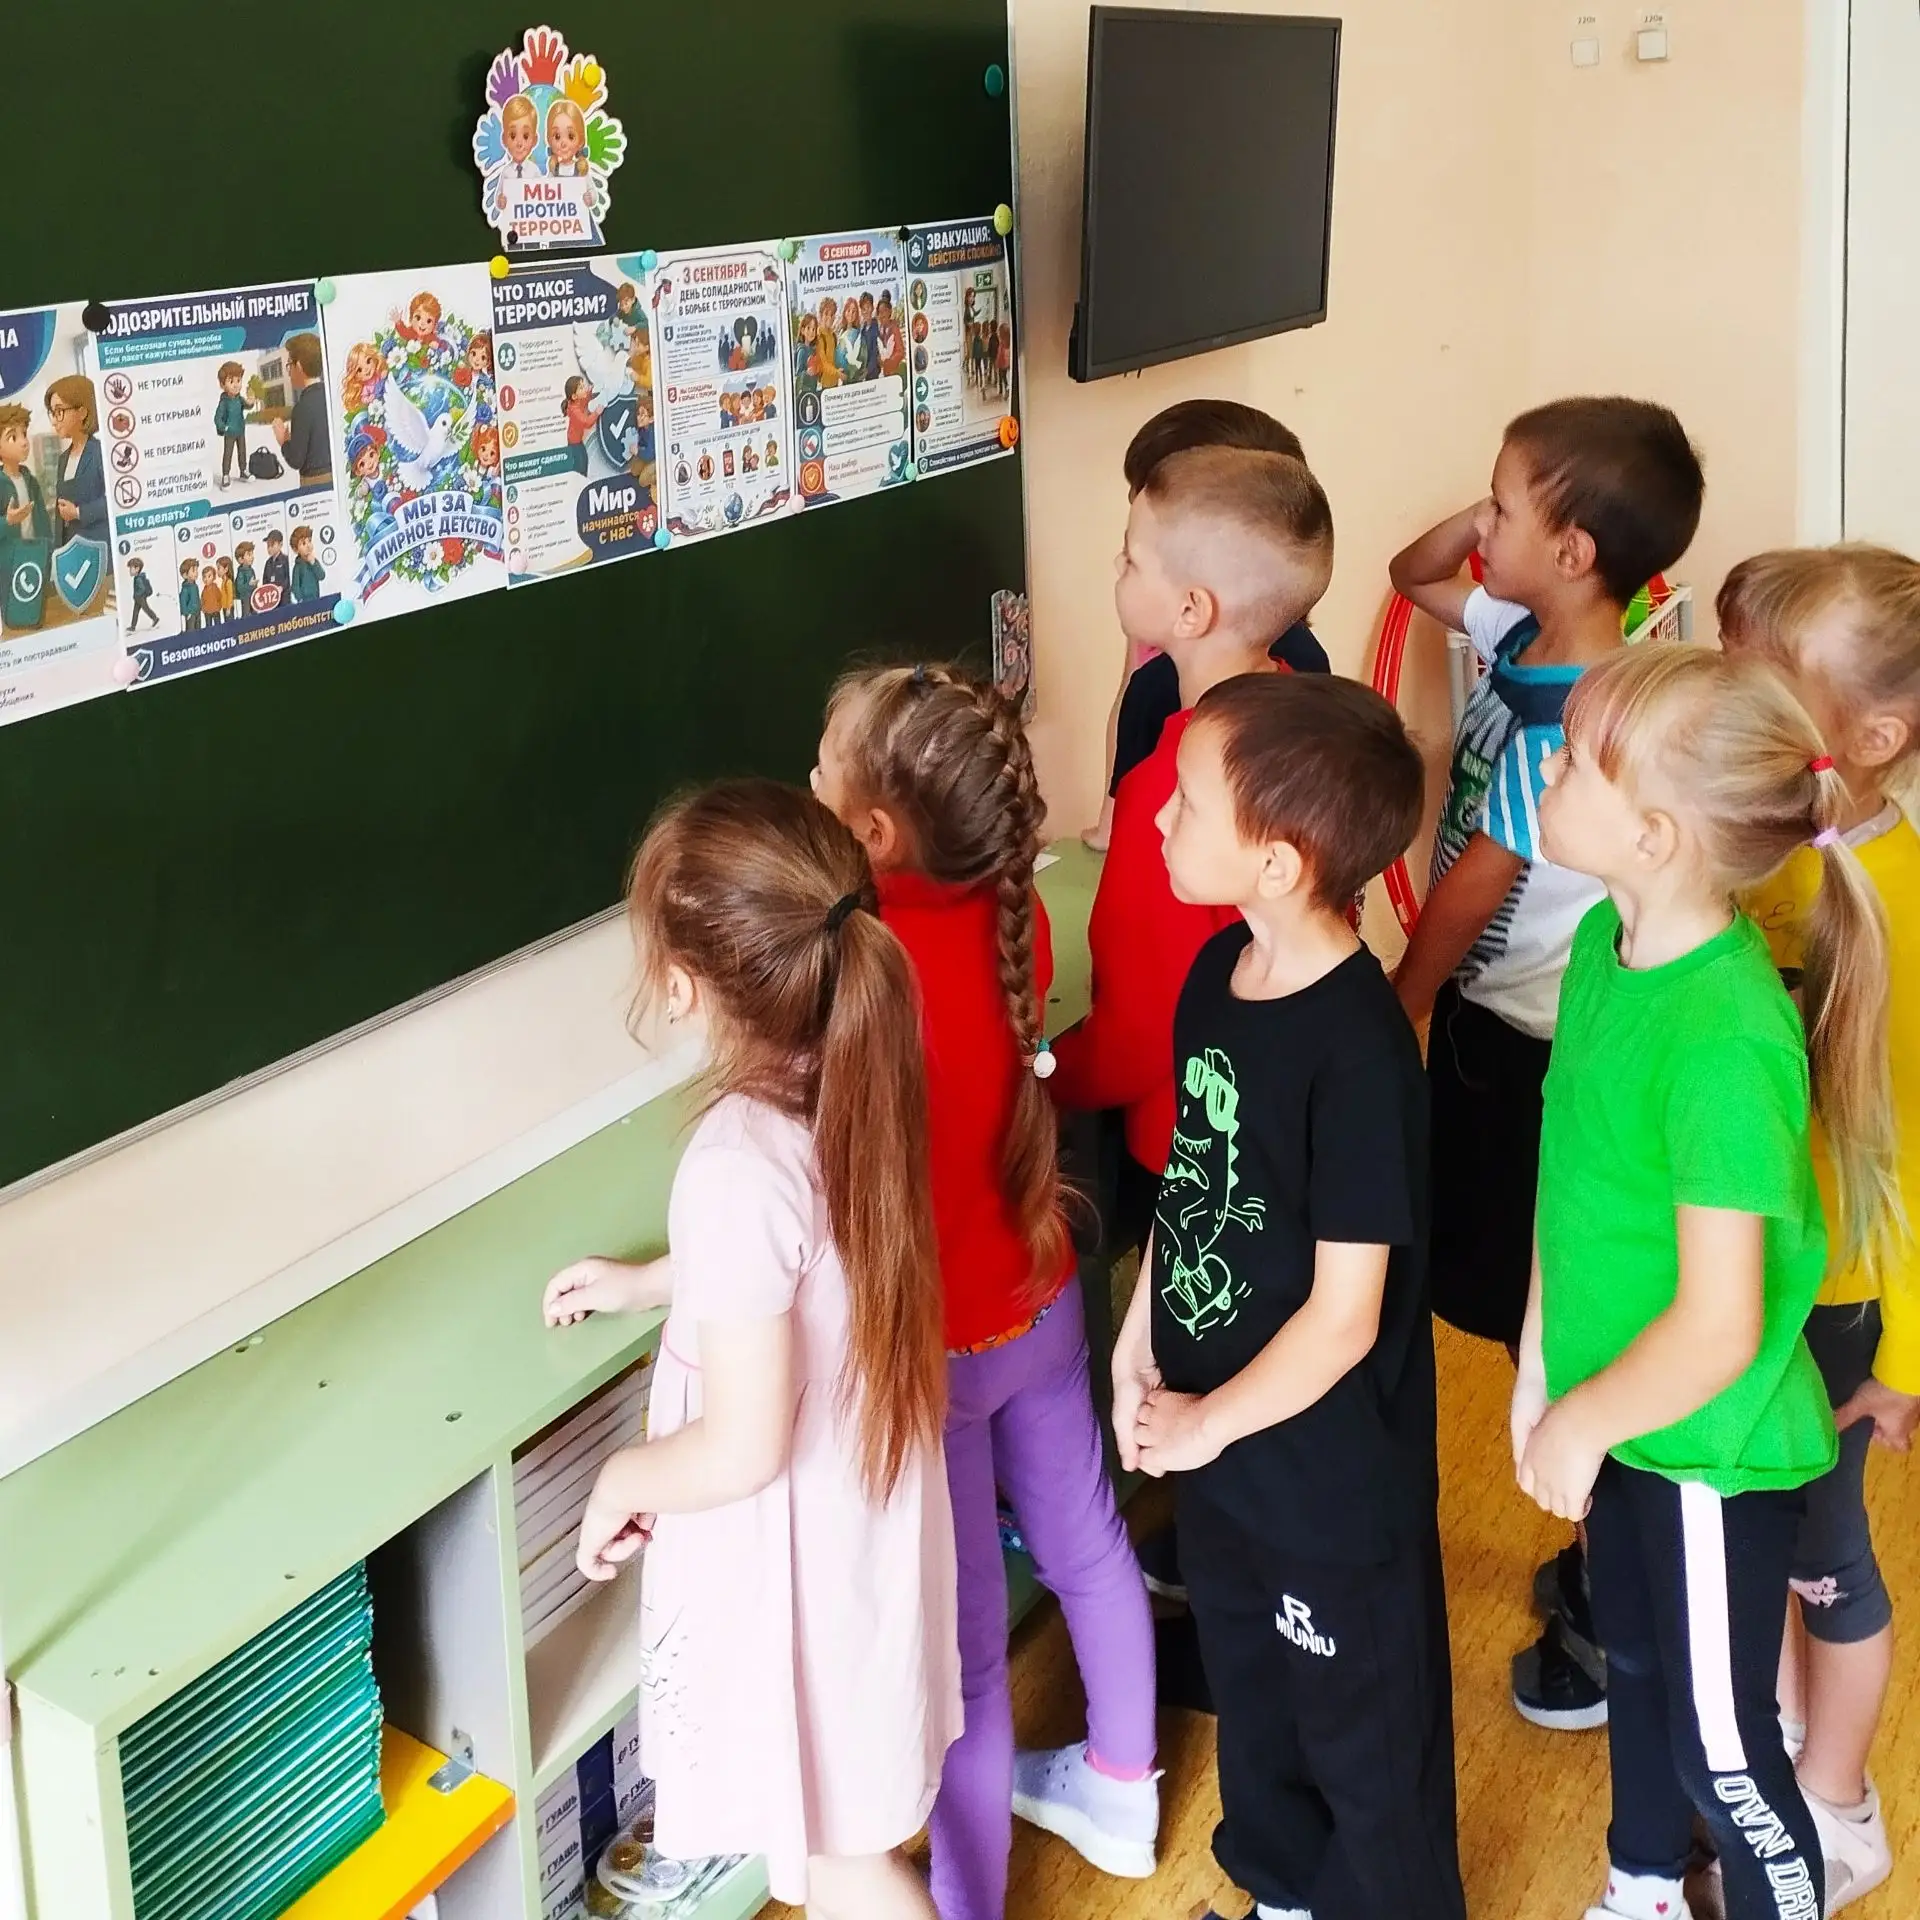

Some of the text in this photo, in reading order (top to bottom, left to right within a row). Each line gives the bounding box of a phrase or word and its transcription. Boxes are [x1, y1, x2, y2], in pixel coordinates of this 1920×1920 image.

[523, 184, 562, 201] МЫ
[514, 202, 577, 218] ПРОТИВ
[509, 219, 584, 237] ТЕРРОРА
[926, 226, 991, 251] ЭВАКУАЦИЯ:
[823, 244, 868, 259] 3 СЕНТЯБРЯ
[683, 267, 691, 284] 3
[693, 263, 747, 282] СЕНТЯБРЯ
[800, 256, 898, 284] МИР БЕЗ ТЕРРОРА
[493, 278, 574, 303] ЧТО ТАКОЕ
[680, 280, 763, 303] ДЕНЬ СОЛИДАРНОСТИ
[97, 292, 310, 336] ОДОЗРИТЕЛЬНЫЙ ПРЕДМЕТ
[495, 294, 607, 326] ТЕРРОРИЗМ?
[679, 295, 766, 316] В БОРЬБЕ С ТЕРРОРИЗМОМ
[104, 333, 222, 355] Если бесхозная сумка, коробка
[106, 354, 119, 364] или
[120, 351, 144, 363] пакет
[145, 347, 177, 361] кажутся
[138, 375, 184, 390] НЕ ТРОГАЙ
[141, 407, 201, 425] НЕ ОТКРЫВАЙ
[144, 439, 206, 459] НЕ ПЕРЕДВИГАЙ
[505, 453, 568, 471] Что может сделать
[146, 469, 202, 488] НЕ ИСПОЛЬЗУЙ
[148, 480, 208, 498] РЯДОМ ТЕЛЕФОН
[403, 493, 466, 524] МЫ ЗА
[588, 486, 636, 516] Мир
[125, 506, 191, 529] Что делать?
[582, 510, 639, 533] начинается
[374, 515, 497, 565] МИРНОЕ ДЕТСТВО
[599, 525, 633, 545] с нас
[263, 590, 278, 604] 112
[161, 637, 236, 666] Безопасность
[237, 626, 276, 645] важнее
[1282, 1594, 1315, 1635] R
[545, 1795, 577, 1828] ГУАШЬ
[1714, 1775, 1796, 1859] OWN
[547, 1841, 579, 1875] ГУАШЬ
